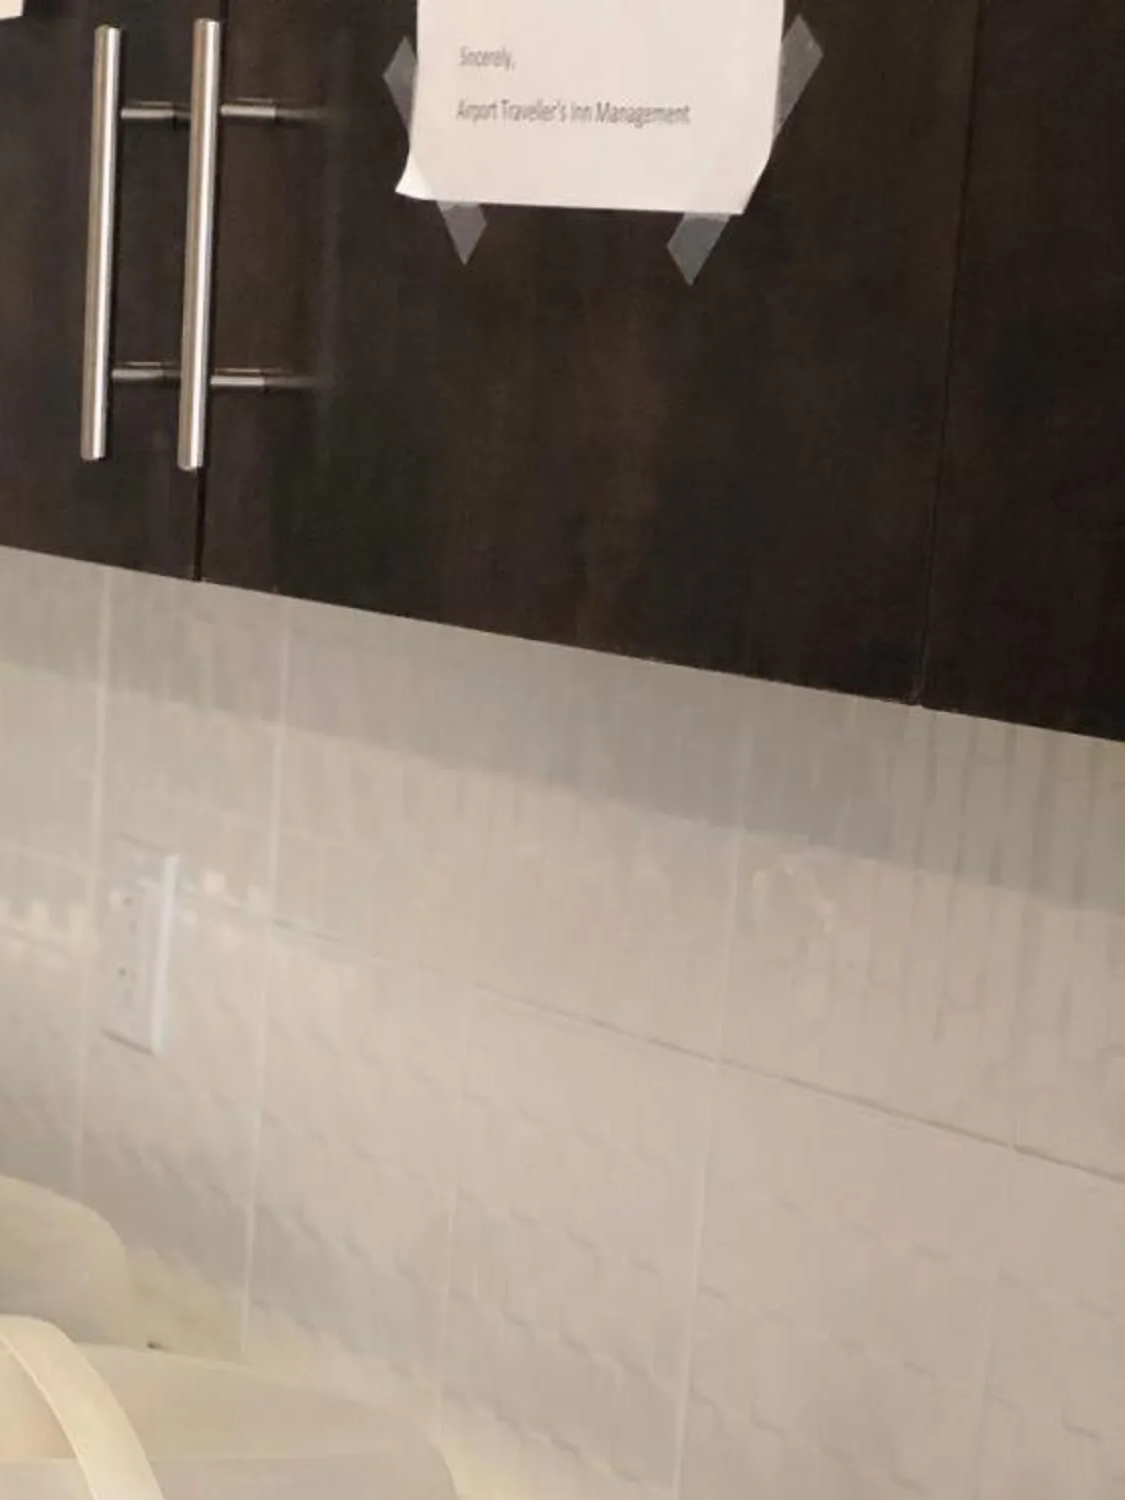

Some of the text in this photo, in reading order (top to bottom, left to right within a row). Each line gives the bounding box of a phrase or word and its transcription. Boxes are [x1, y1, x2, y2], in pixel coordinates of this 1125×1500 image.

[456, 99, 691, 128] Airport Traveller's Inn Management
